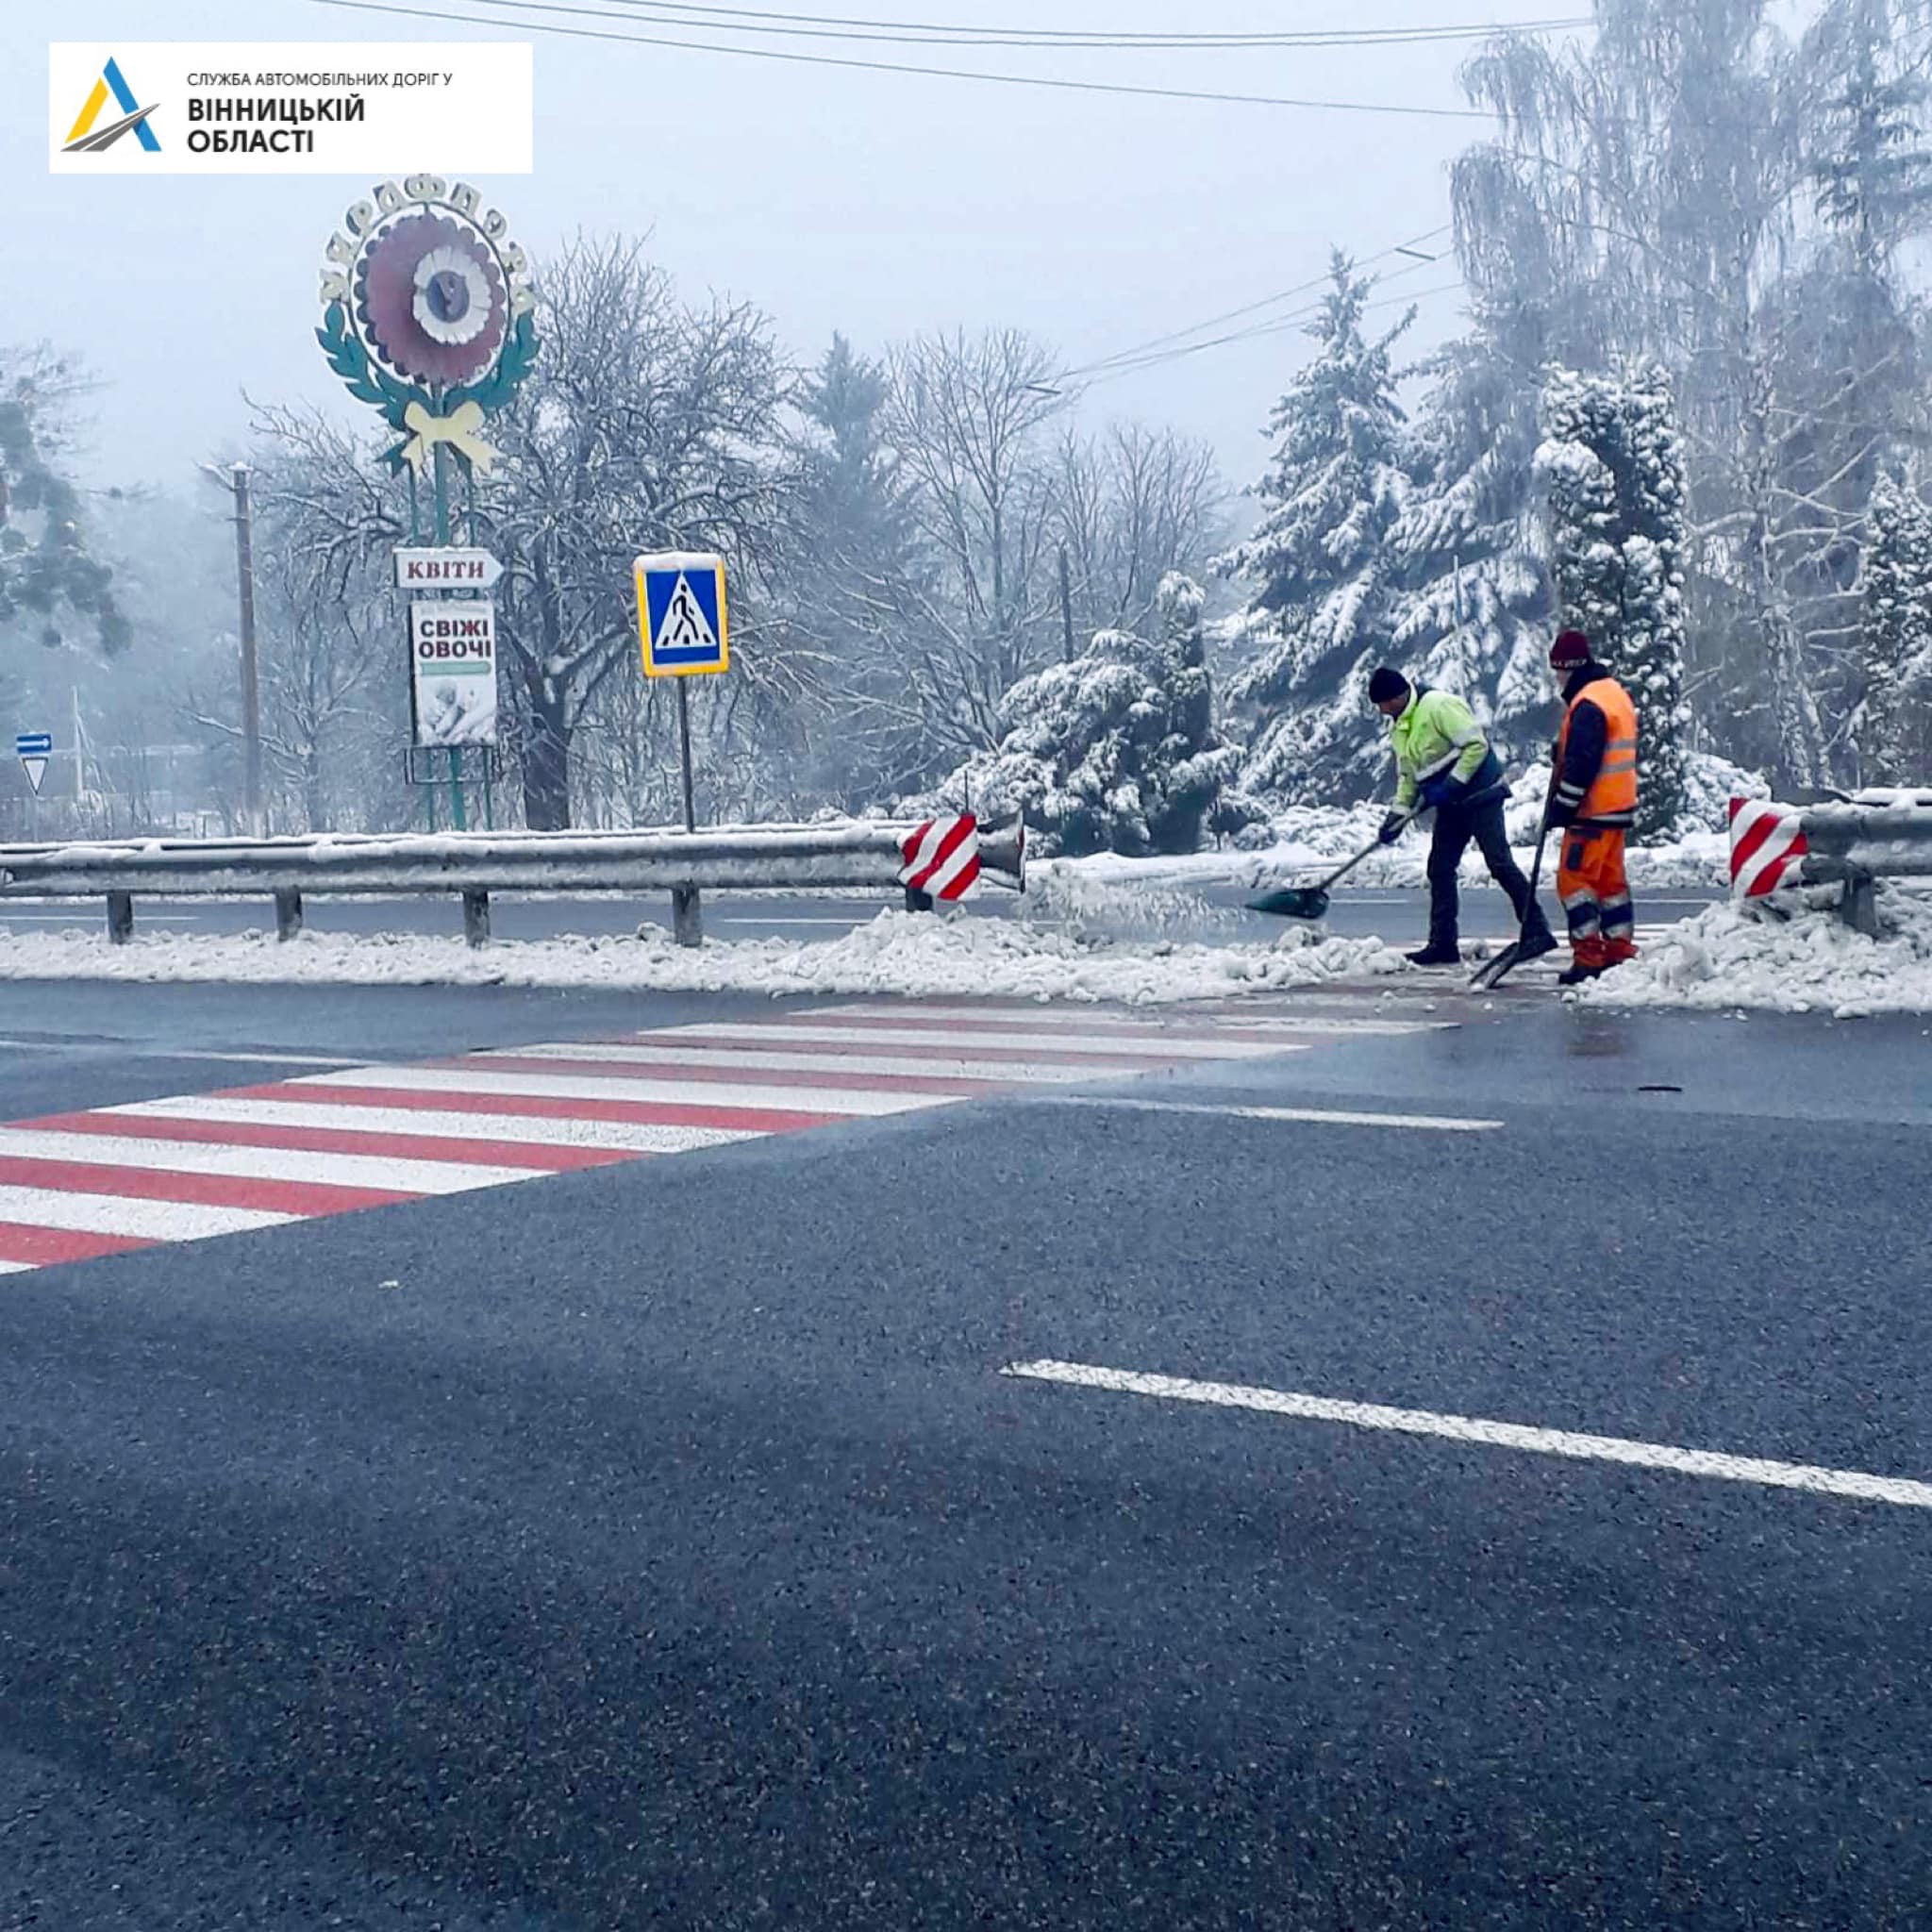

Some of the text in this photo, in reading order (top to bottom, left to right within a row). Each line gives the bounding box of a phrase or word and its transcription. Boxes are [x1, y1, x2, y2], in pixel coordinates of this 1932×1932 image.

[408, 561, 484, 579] КВІТИ
[421, 620, 489, 637] СВІЖІ
[419, 641, 491, 658] ОВОЧІ
